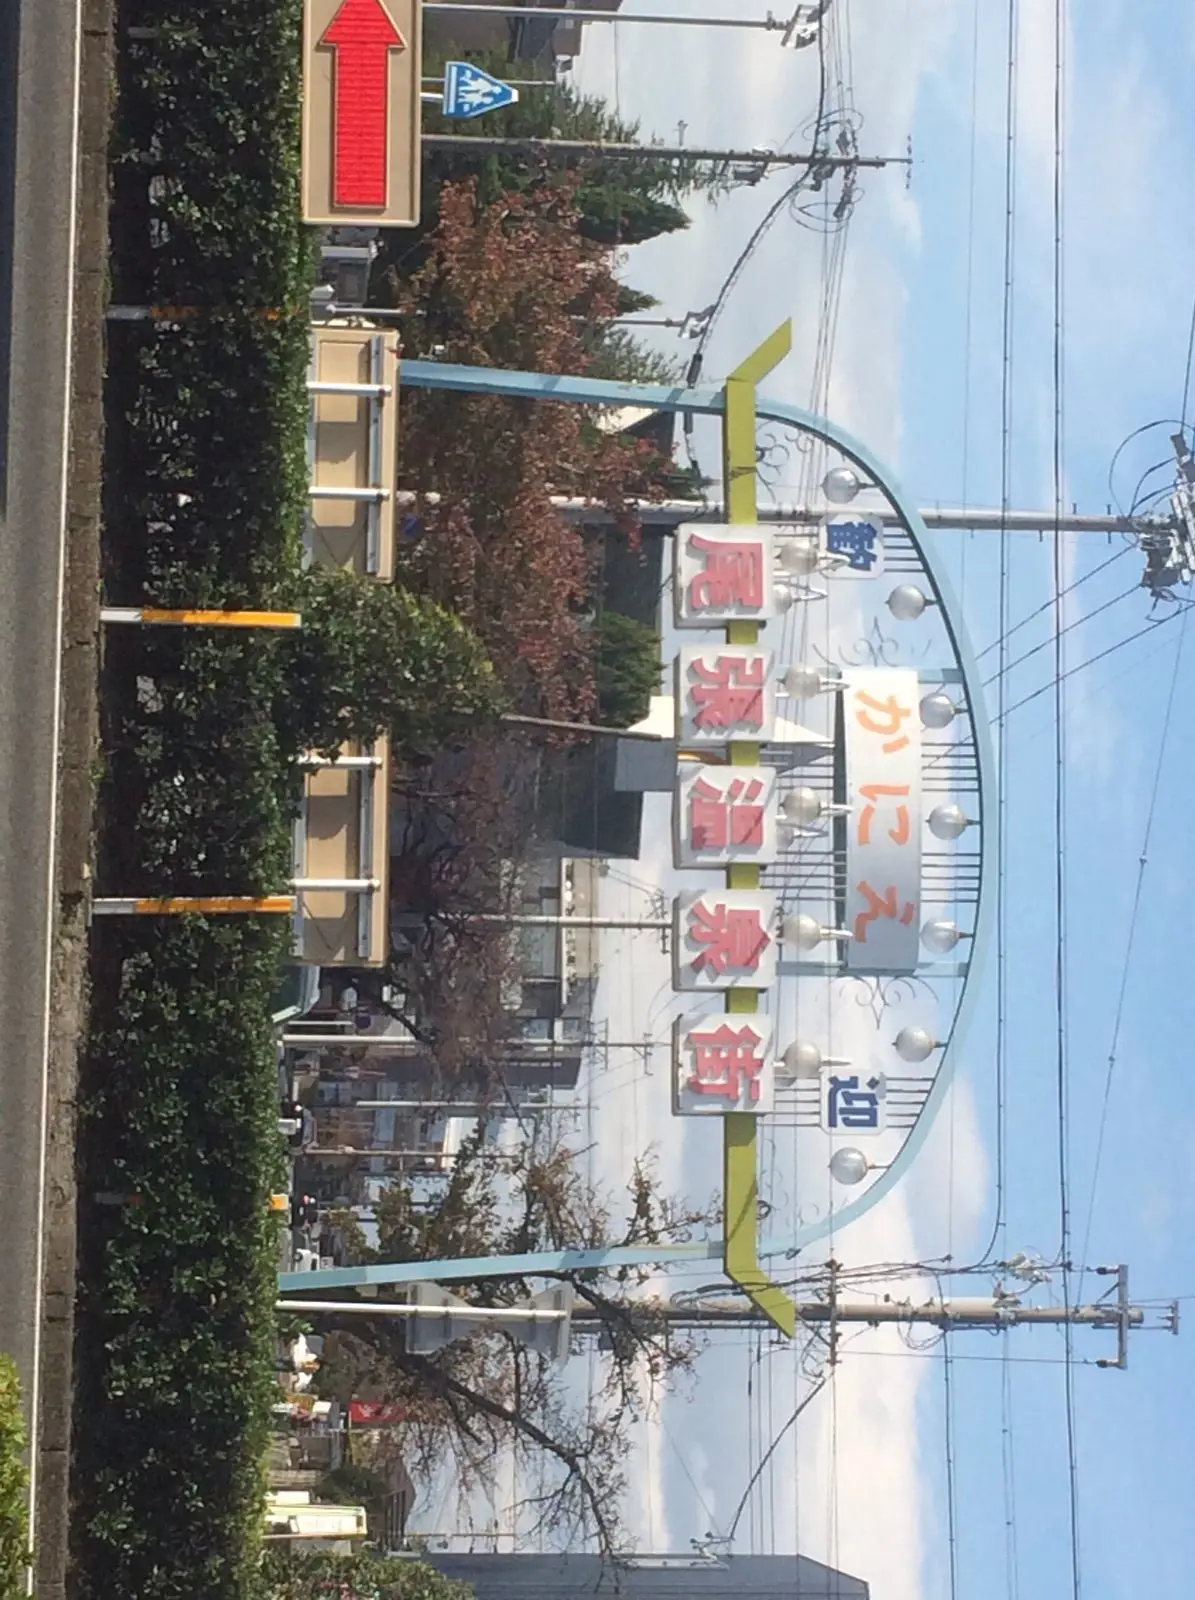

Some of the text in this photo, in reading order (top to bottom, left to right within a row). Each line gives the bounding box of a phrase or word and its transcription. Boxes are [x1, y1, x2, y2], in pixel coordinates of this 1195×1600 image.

[686, 534, 770, 1101] 尾張温泉街
[827, 520, 879, 1128] 歓 迎
[855, 691, 916, 943] かにえ
